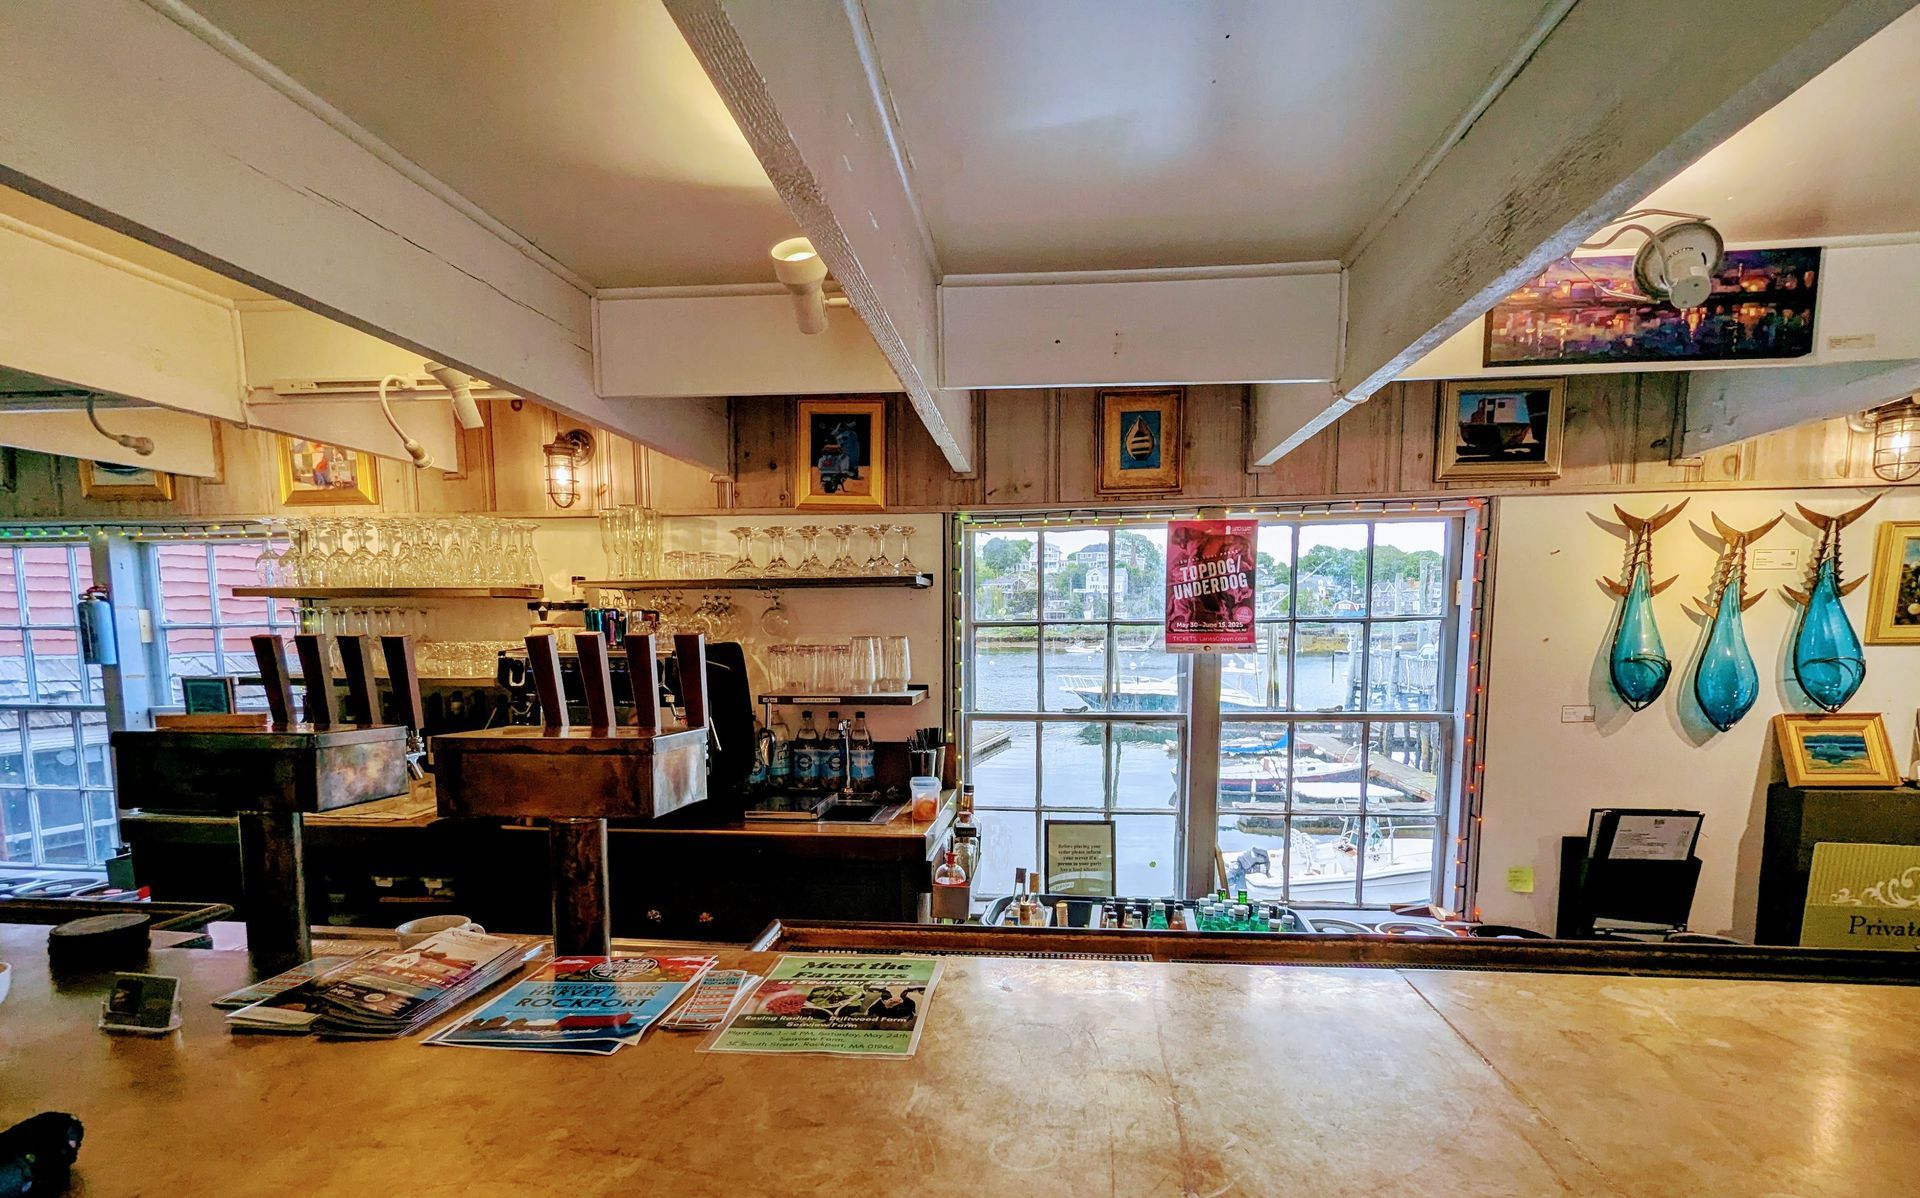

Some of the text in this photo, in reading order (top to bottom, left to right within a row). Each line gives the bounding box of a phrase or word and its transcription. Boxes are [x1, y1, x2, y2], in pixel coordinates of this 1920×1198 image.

[1180, 555, 1241, 582] TOPDOG/
[1173, 572, 1248, 600] UNDERDOG
[800, 961, 912, 970] Meet the
[792, 971, 910, 979] Farmers
[529, 988, 660, 997] HARVEY PARK
[514, 998, 650, 1008] ROCKPORT
